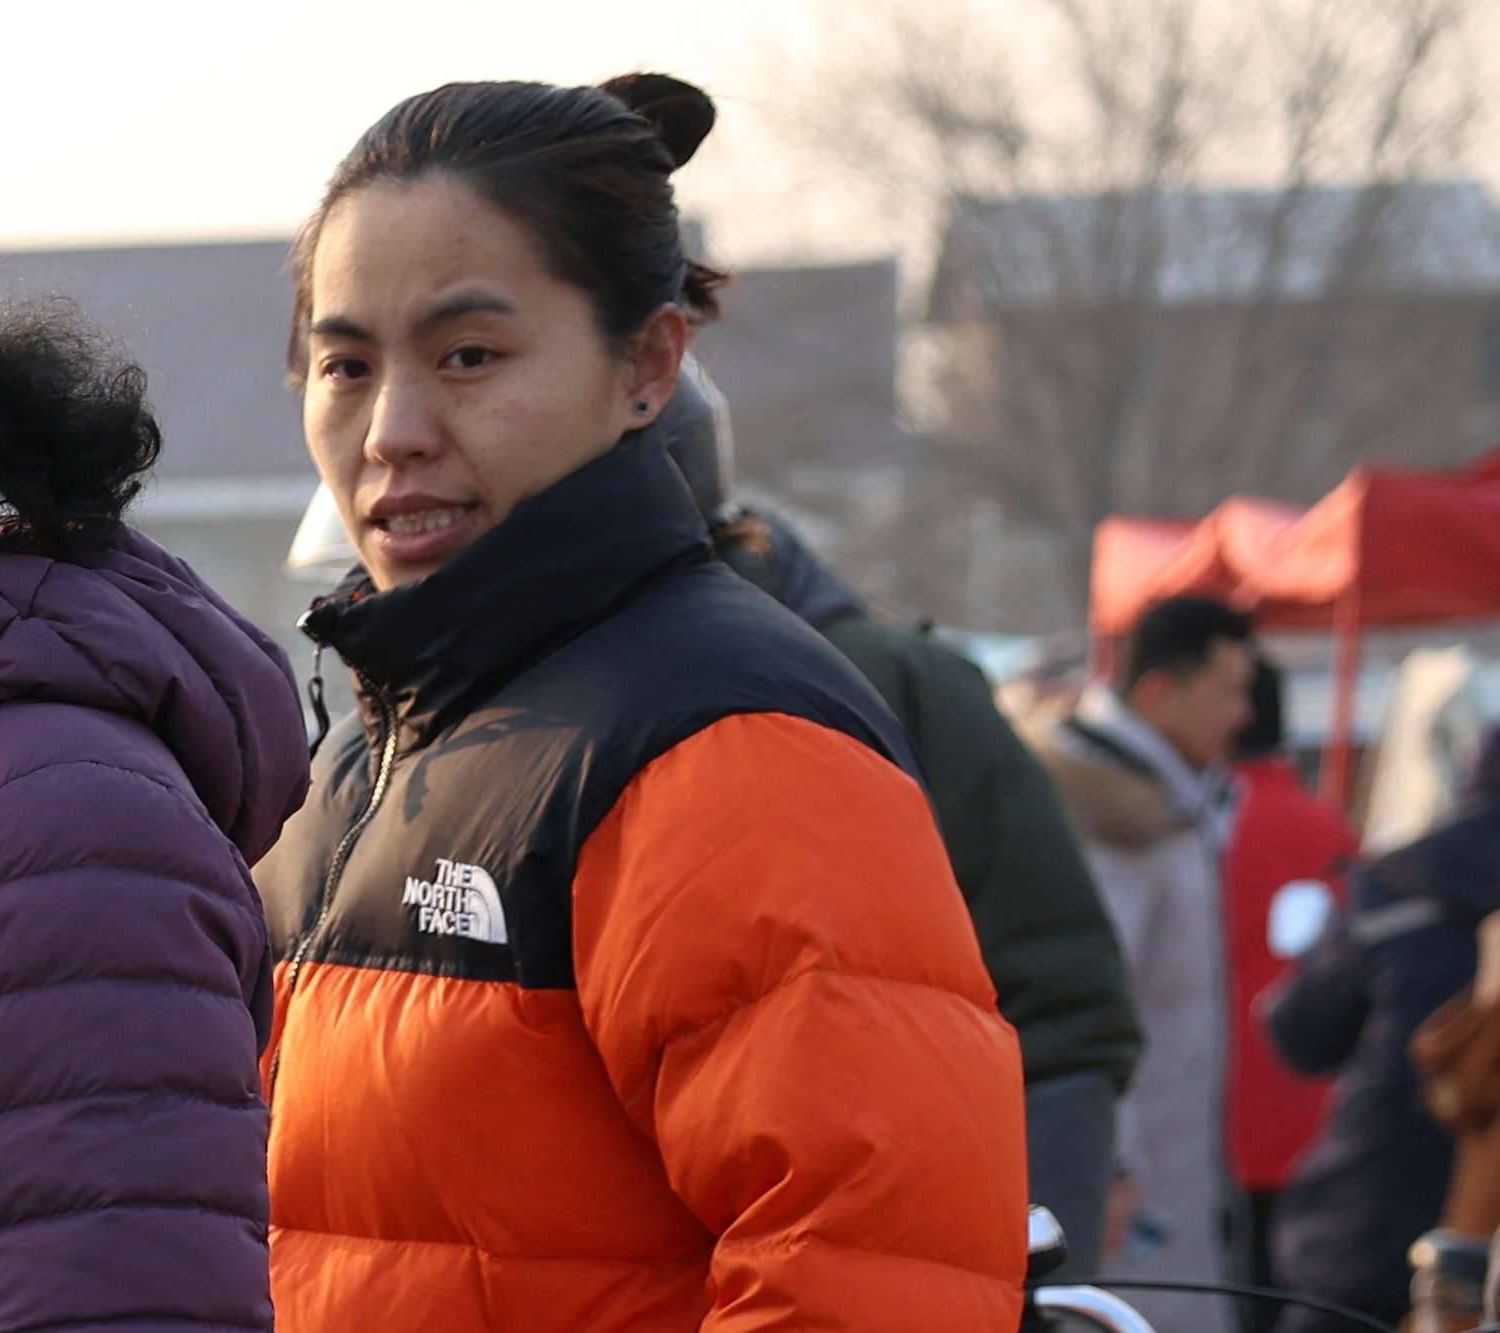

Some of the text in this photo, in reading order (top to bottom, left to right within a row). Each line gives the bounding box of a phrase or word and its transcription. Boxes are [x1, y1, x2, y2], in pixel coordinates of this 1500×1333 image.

[435, 858, 473, 887] THE
[401, 876, 473, 914] NORTH
[419, 907, 474, 936] FACE
